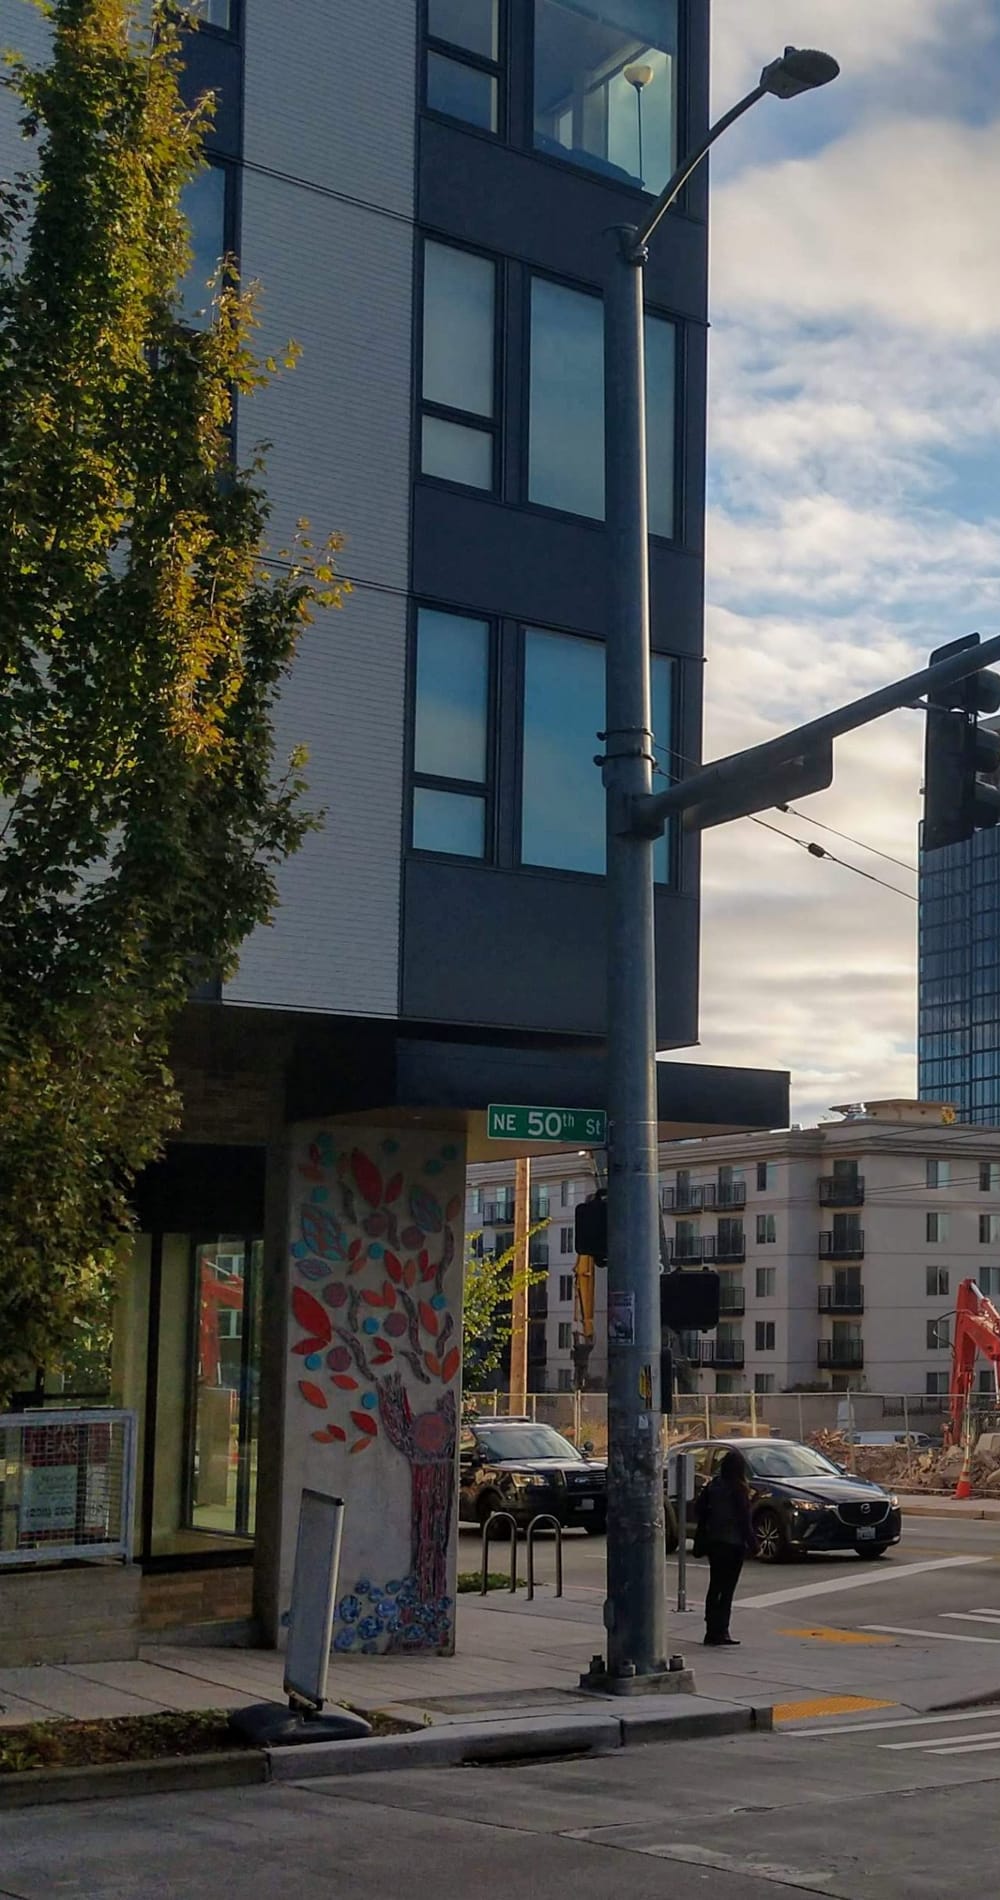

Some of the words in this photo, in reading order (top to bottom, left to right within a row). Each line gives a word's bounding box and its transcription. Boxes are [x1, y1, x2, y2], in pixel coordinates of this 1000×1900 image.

[493, 1113, 516, 1131] NE
[528, 1112, 575, 1136] 50th
[585, 1119, 601, 1135] St
